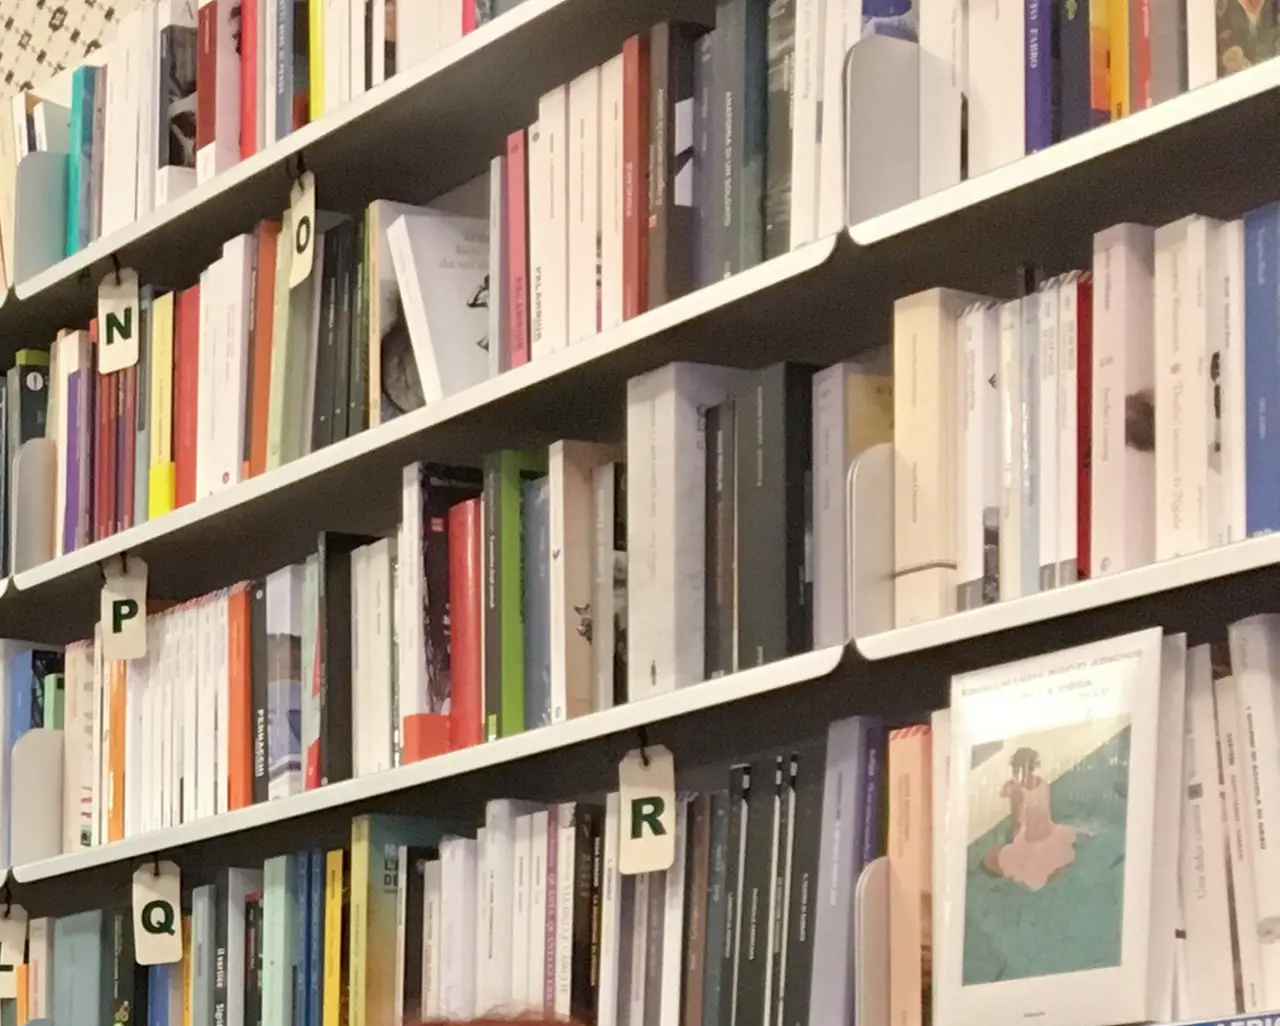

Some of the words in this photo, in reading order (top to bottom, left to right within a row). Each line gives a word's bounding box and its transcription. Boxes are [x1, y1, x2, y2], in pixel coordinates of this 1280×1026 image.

[295, 215, 311, 252] O
[105, 307, 132, 345] N
[112, 599, 139, 633] P
[630, 796, 668, 841] R
[141, 899, 176, 937] Q
